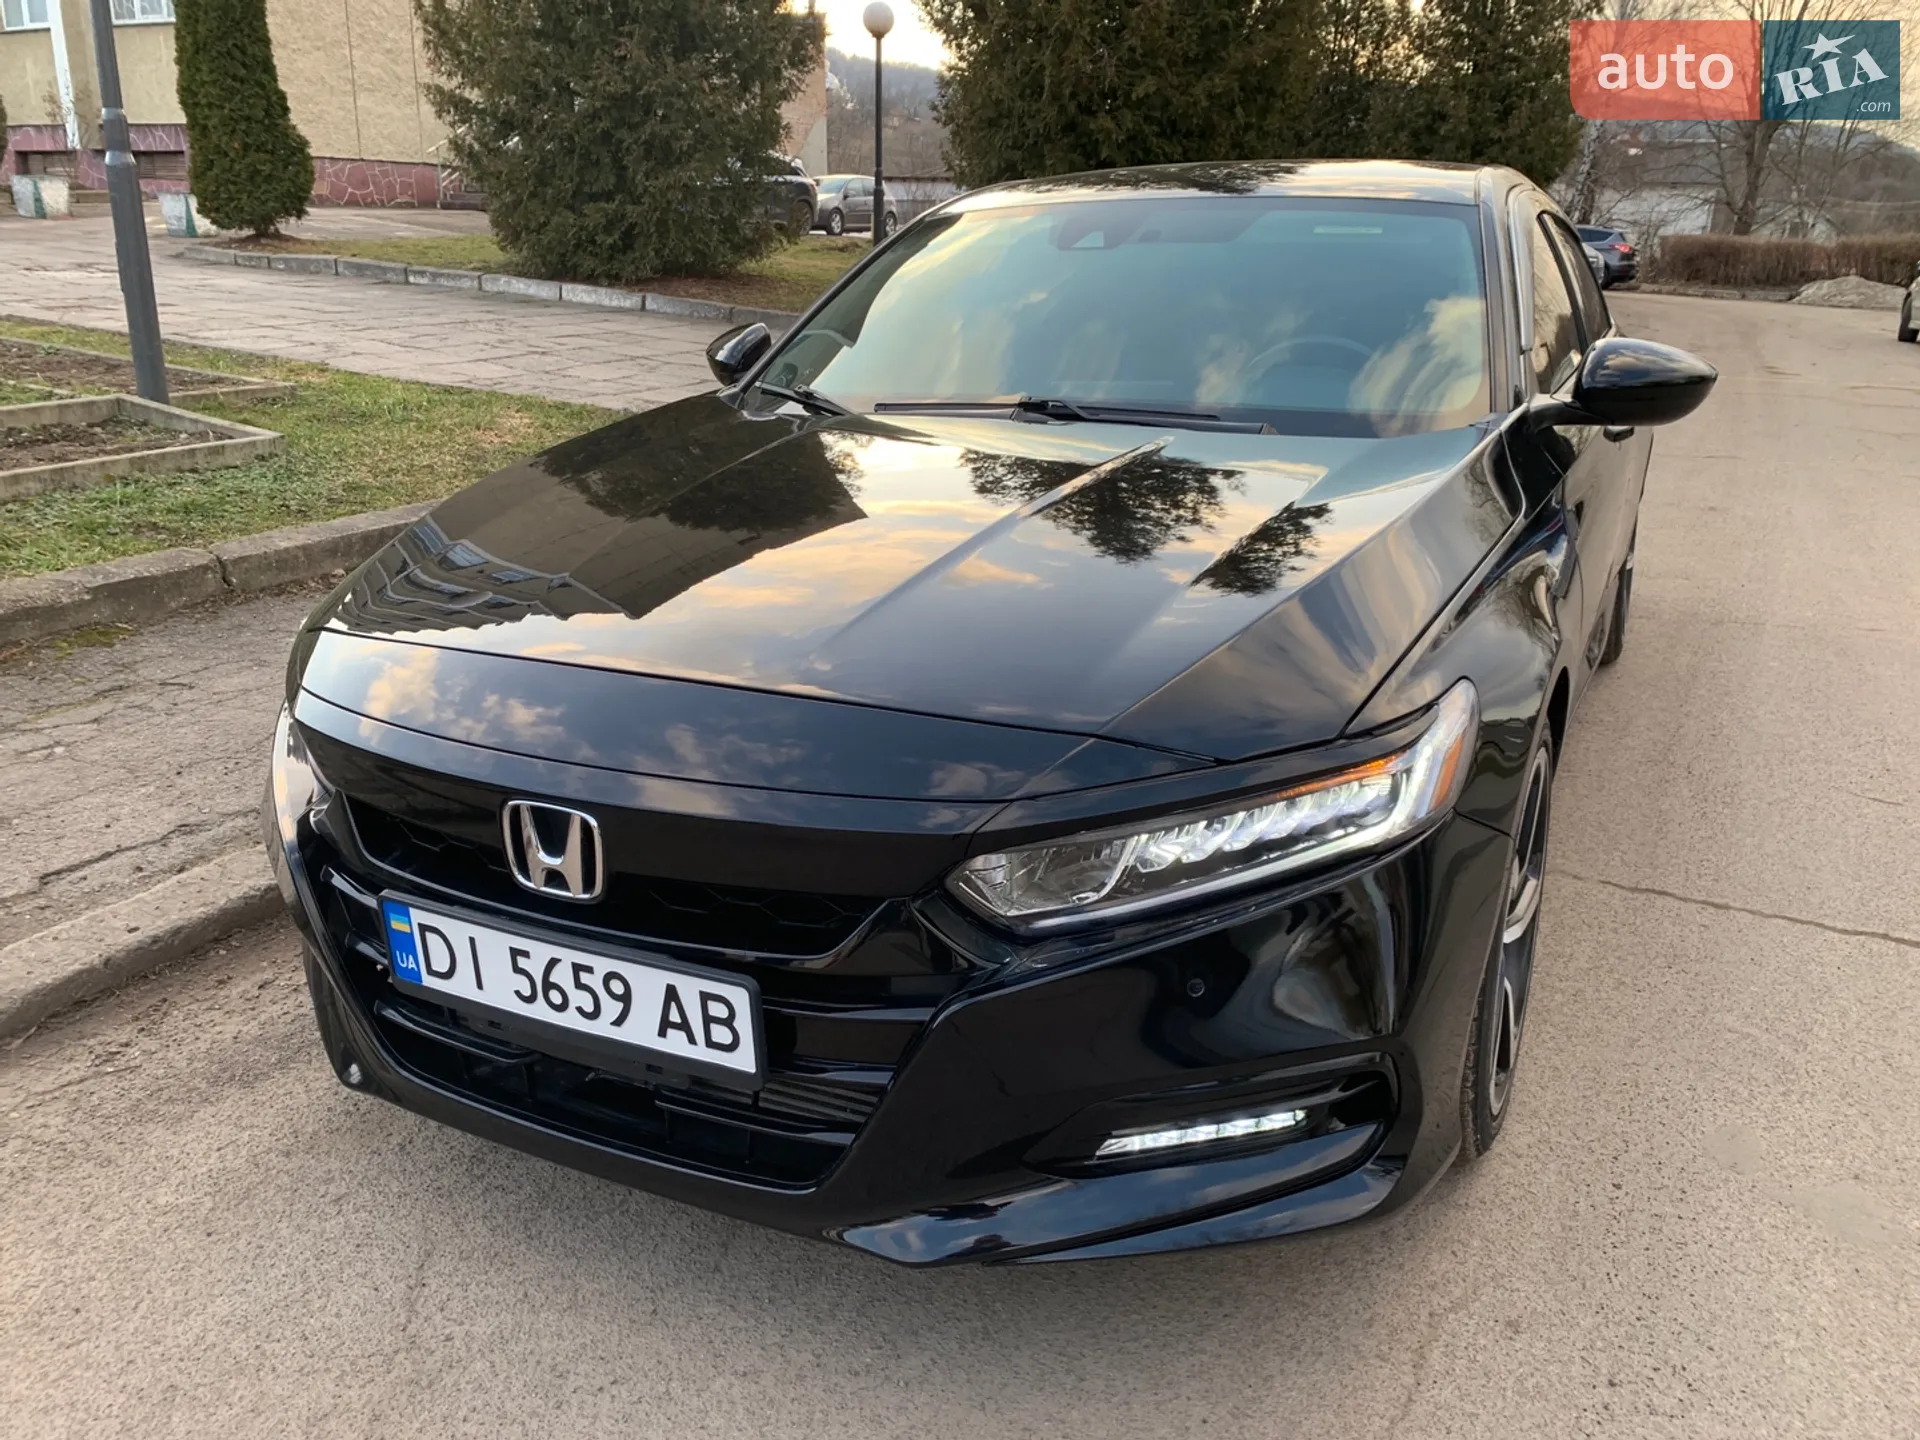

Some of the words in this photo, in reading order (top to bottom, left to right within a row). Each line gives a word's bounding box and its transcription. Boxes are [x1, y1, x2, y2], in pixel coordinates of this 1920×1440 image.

[396, 950, 418, 972] UA
[417, 922, 483, 991] DI
[508, 946, 632, 1027] 5659
[657, 983, 741, 1053] AB
